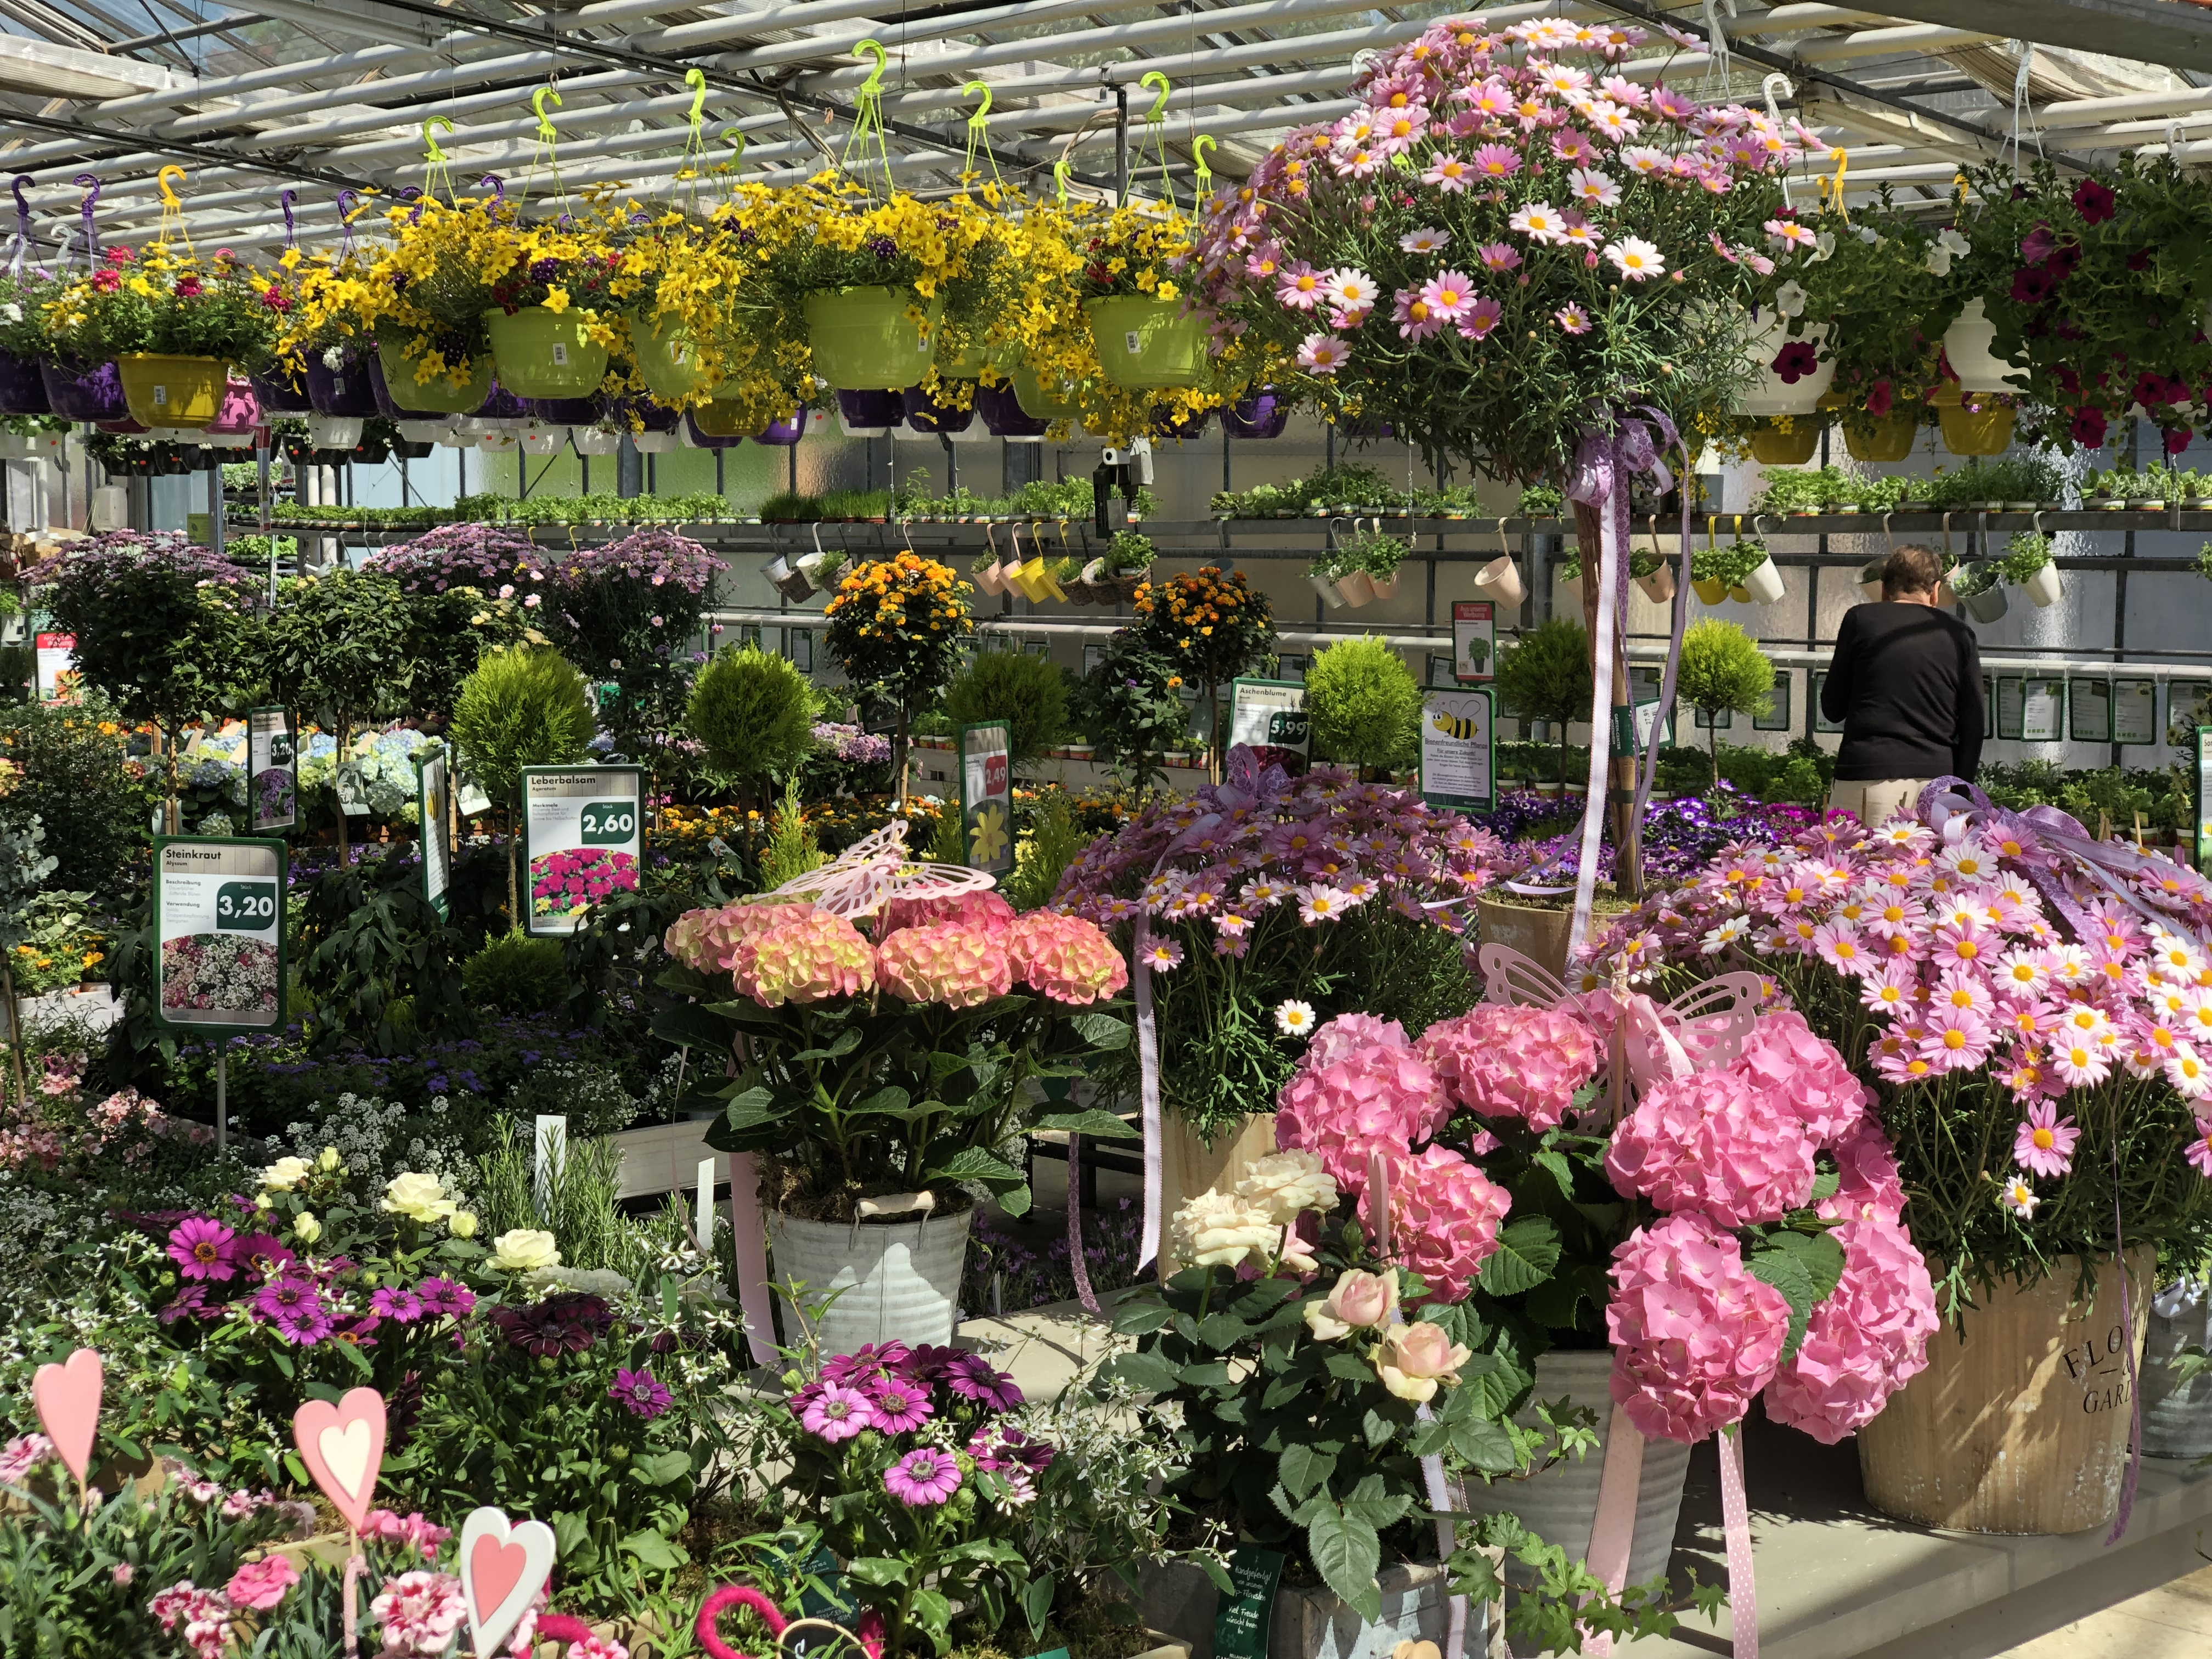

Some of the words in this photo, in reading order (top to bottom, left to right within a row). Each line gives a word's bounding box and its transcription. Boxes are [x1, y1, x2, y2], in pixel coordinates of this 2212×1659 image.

[1240, 687, 1286, 697] Aschenblume
[1643, 709, 1651, 725] 27.99
[1270, 720, 1306, 736] 5,99
[272, 742, 291, 758] 3,20
[1425, 738, 1469, 747] Bienenfreundliche
[531, 775, 596, 785] Leberbalsam
[986, 766, 1006, 786] 2,49
[583, 814, 633, 834] 2,60
[166, 849, 221, 860] Steinkraut
[218, 895, 273, 918] 3,20
[1229, 1605, 1239, 1615] Viel
[1241, 1608, 1259, 1619] Freude
